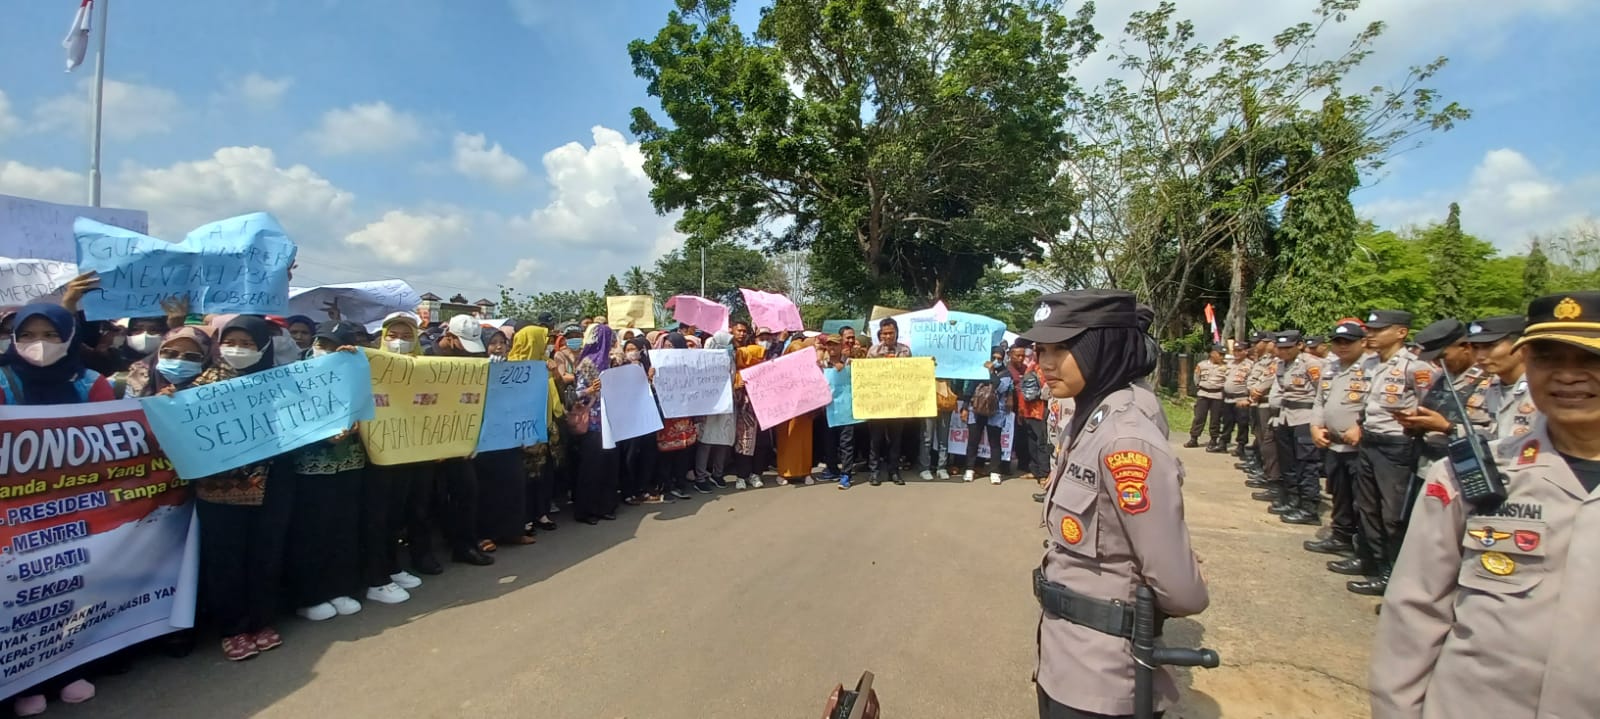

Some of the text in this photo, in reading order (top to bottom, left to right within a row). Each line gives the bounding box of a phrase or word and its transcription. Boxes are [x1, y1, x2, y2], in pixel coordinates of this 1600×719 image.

[195, 362, 314, 401] GAJI HONORER
[369, 354, 415, 386] GAJI
[247, 383, 287, 409] DARI
[296, 370, 342, 394] KATA
[194, 388, 348, 452] SEJAHTERA
[367, 416, 417, 453] KAPAN
[514, 419, 540, 440] PPPK
[52, 472, 100, 490] Jasa
[106, 463, 146, 480] Yang
[7, 489, 107, 527] PRESIDEN
[110, 482, 167, 503] Tanpa
[12, 520, 88, 552] MENTRI
[18, 547, 87, 581] BUPATI
[15, 575, 84, 605] SEKDA
[11, 600, 73, 632] KADIS
[40, 601, 108, 637] BANYAKNYA
[67, 609, 119, 637] TENTANG
[119, 594, 151, 613] NASIB
[3, 639, 75, 679] YANG TULUS
